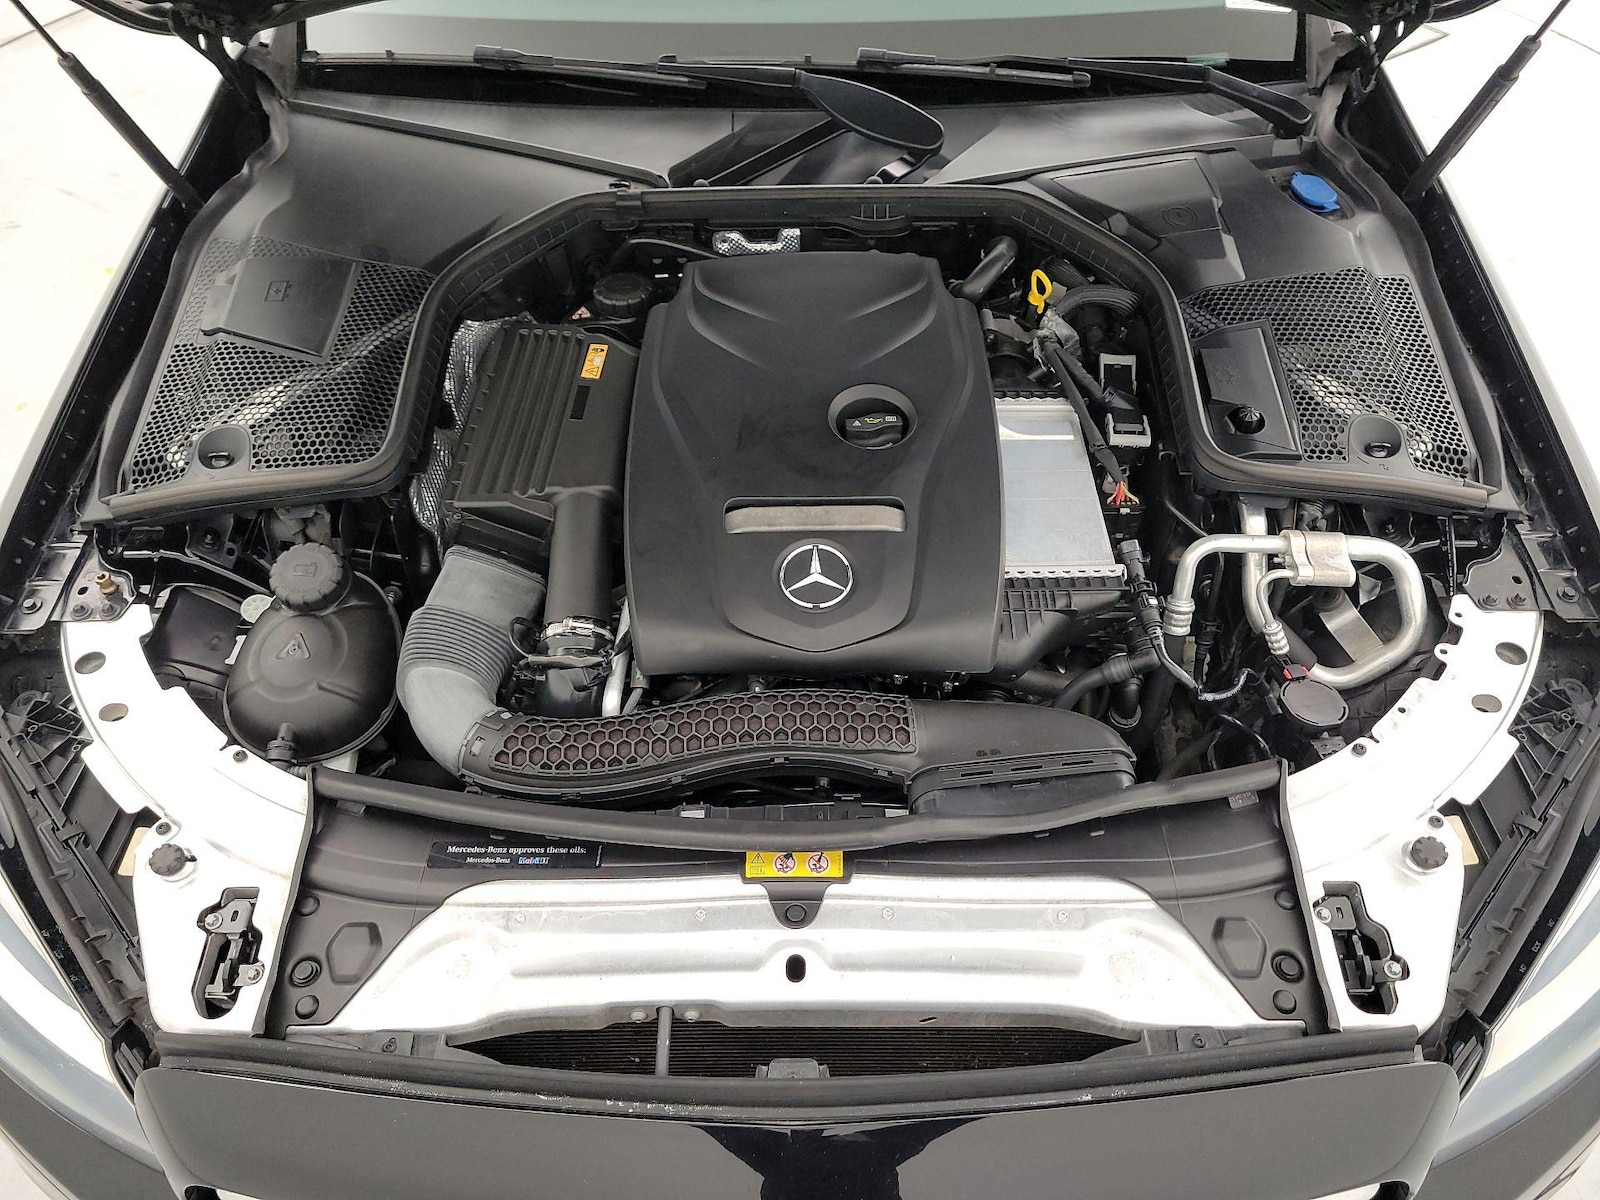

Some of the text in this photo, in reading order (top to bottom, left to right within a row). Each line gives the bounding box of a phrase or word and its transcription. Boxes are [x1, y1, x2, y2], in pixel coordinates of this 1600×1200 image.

[446, 845, 587, 855] Mercedes-Benz approves these oils:
[465, 856, 511, 864] Mercedes-Benz
